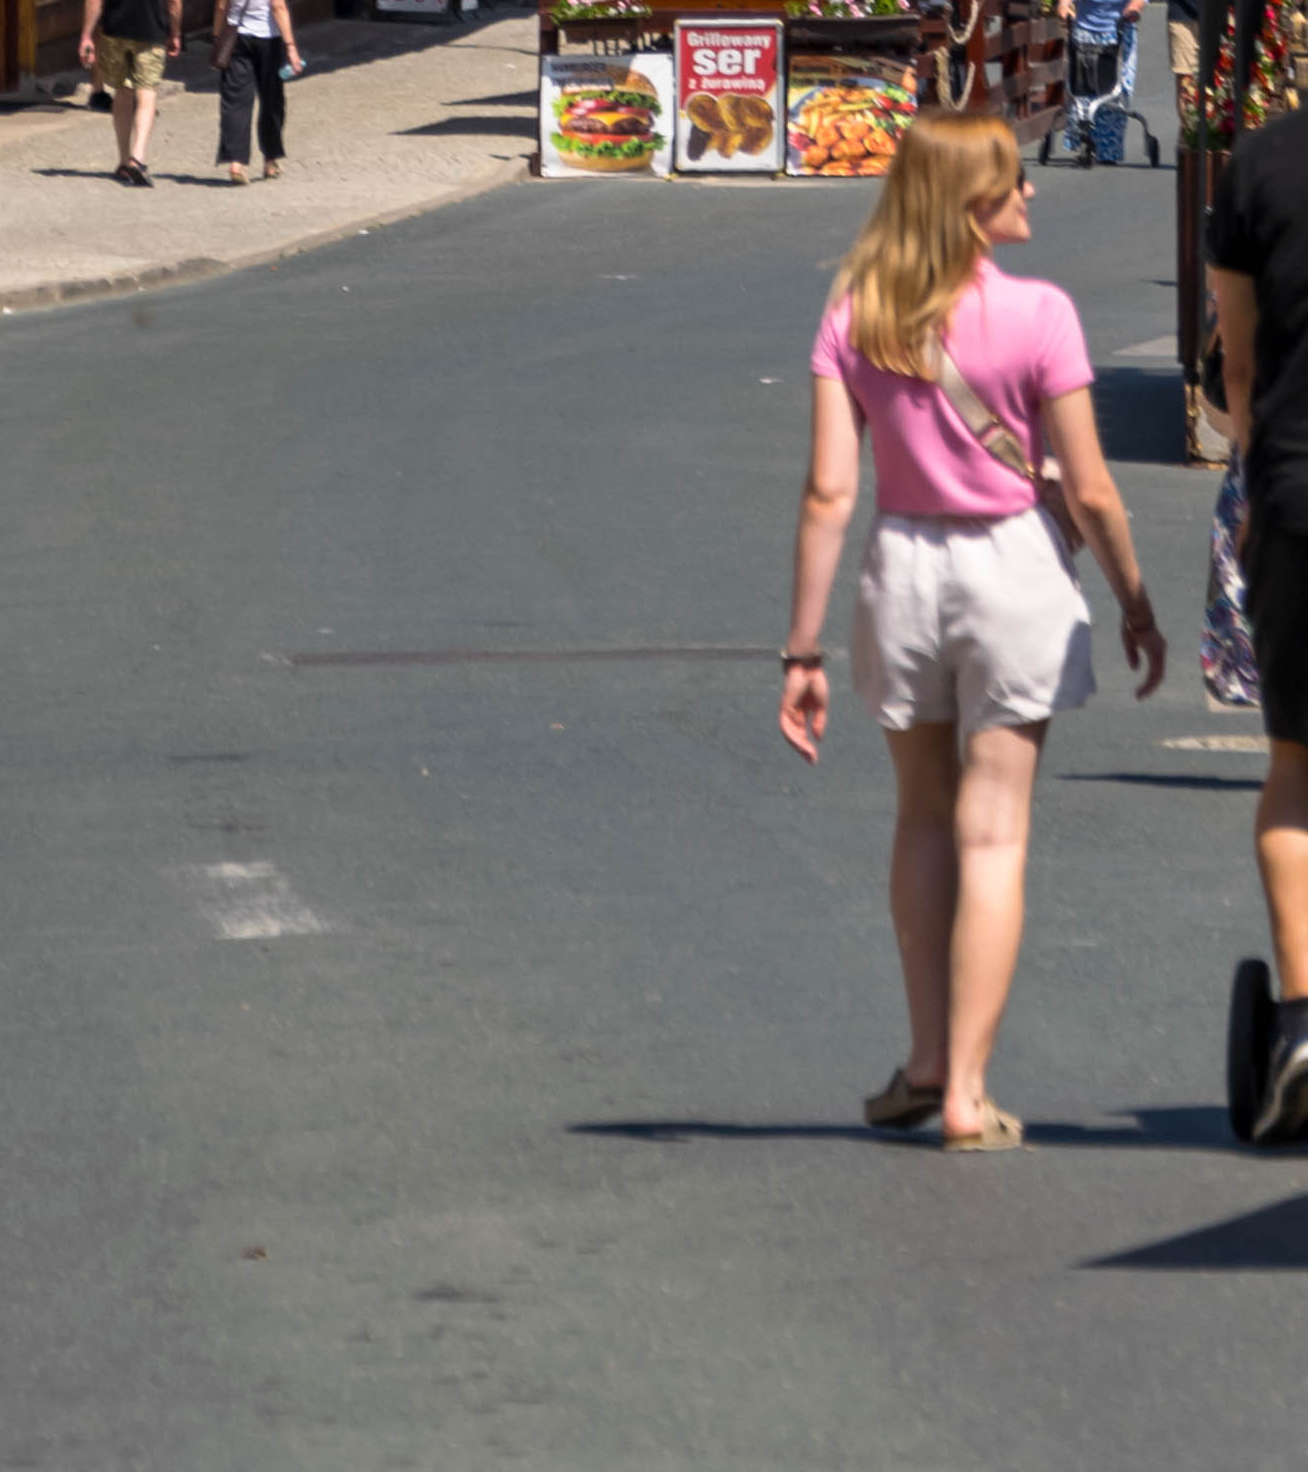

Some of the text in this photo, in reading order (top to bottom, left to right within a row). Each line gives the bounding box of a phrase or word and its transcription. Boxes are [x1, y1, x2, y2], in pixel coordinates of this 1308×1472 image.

[687, 32, 771, 49] Grillowany
[693, 49, 762, 76] ser
[688, 79, 697, 89] z
